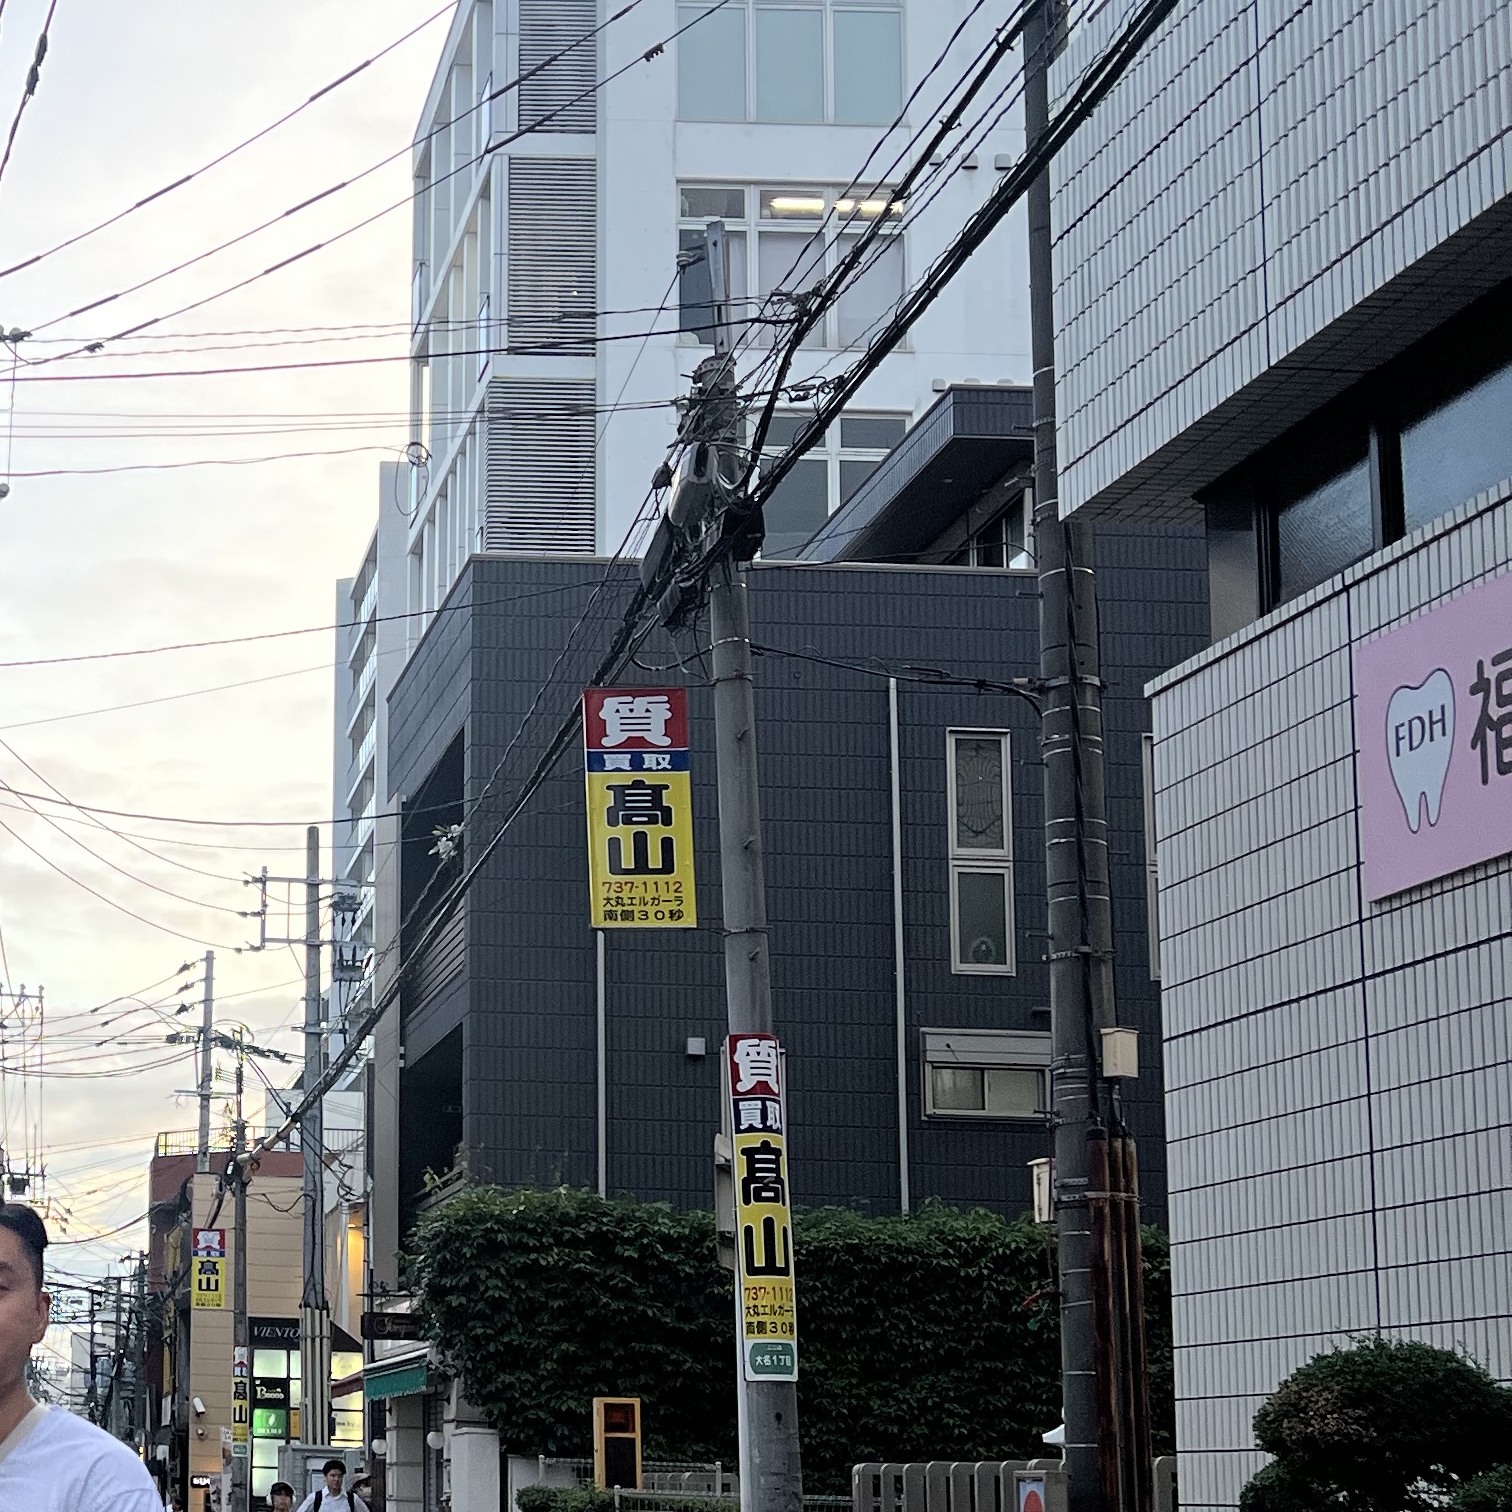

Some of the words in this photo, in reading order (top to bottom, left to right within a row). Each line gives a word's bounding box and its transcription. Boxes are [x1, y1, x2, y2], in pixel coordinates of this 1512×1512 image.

[598, 694, 673, 748] 質
[1394, 703, 1447, 757] FDH
[603, 753, 673, 771] 買取
[602, 881, 684, 894] 737-1112
[602, 895, 685, 908] 大丸エルガーラ
[733, 1038, 780, 1094] 質
